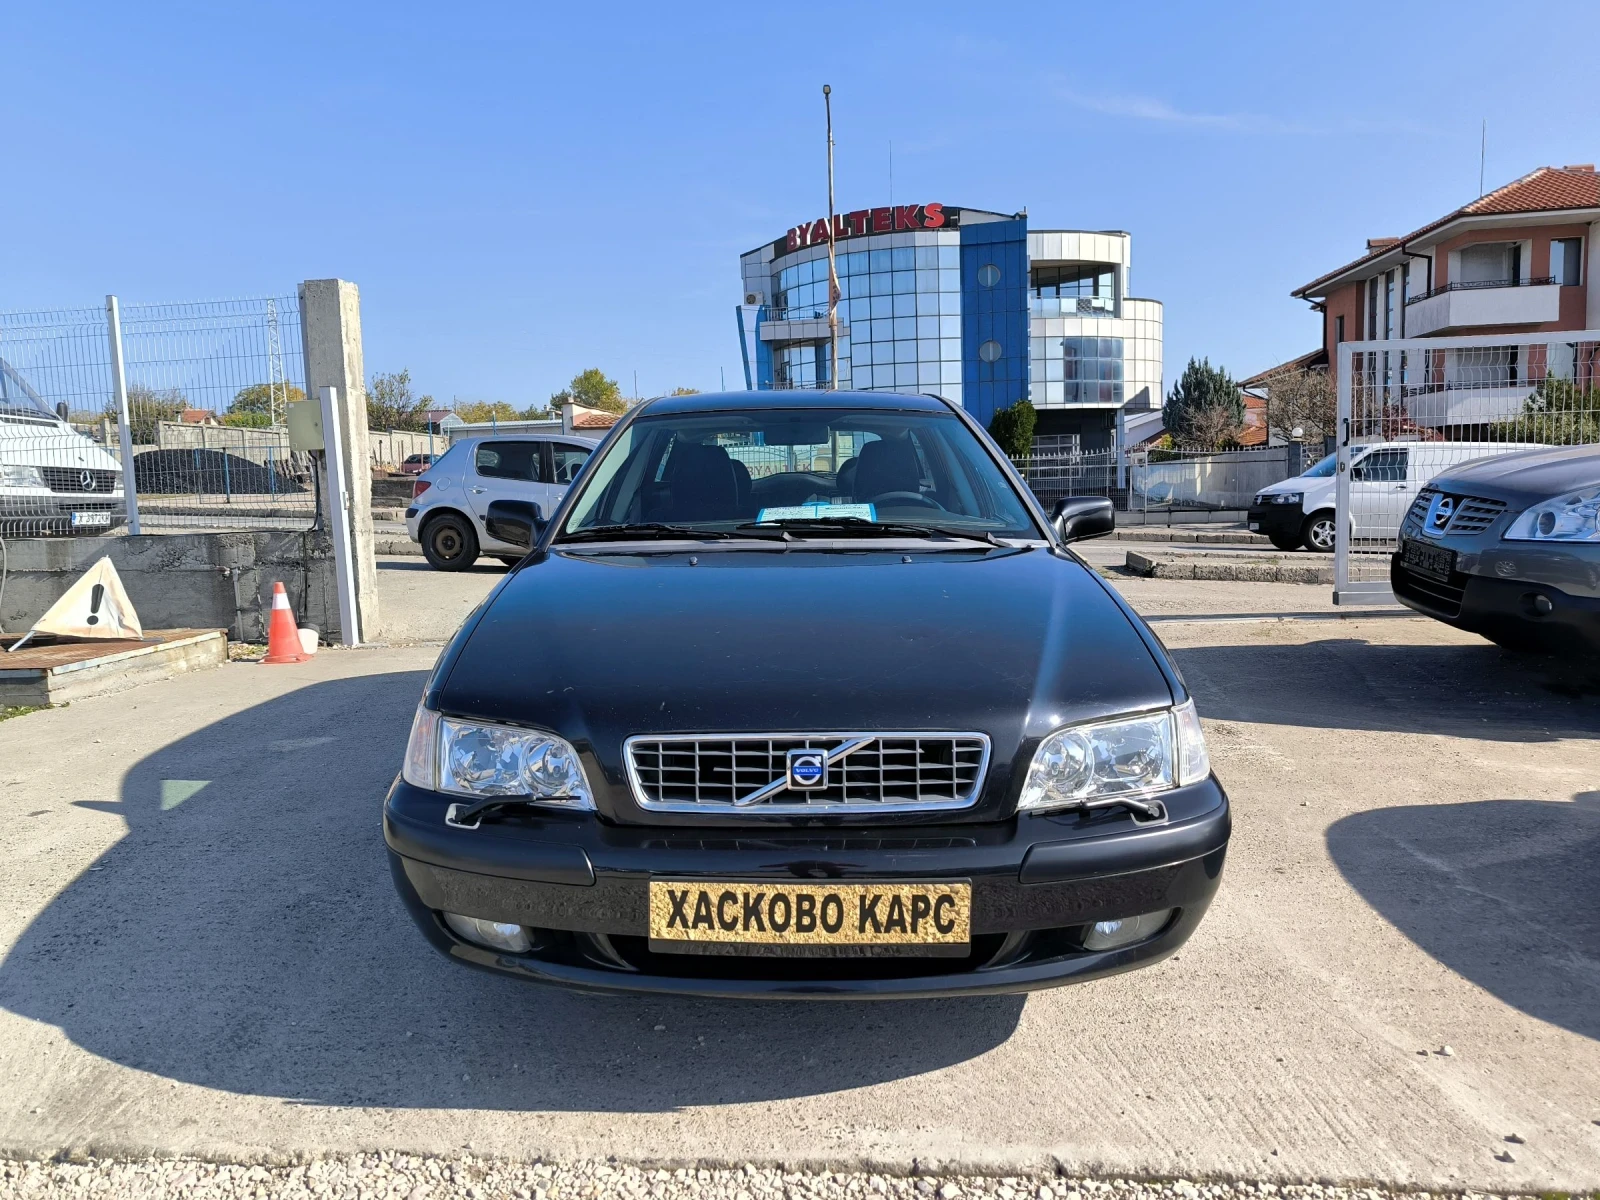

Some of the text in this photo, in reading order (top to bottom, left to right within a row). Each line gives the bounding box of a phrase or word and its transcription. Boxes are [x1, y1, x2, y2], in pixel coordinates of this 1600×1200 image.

[787, 202, 945, 250] BYALTEKS
[666, 889, 957, 935] ХАСКОВО КАРС
